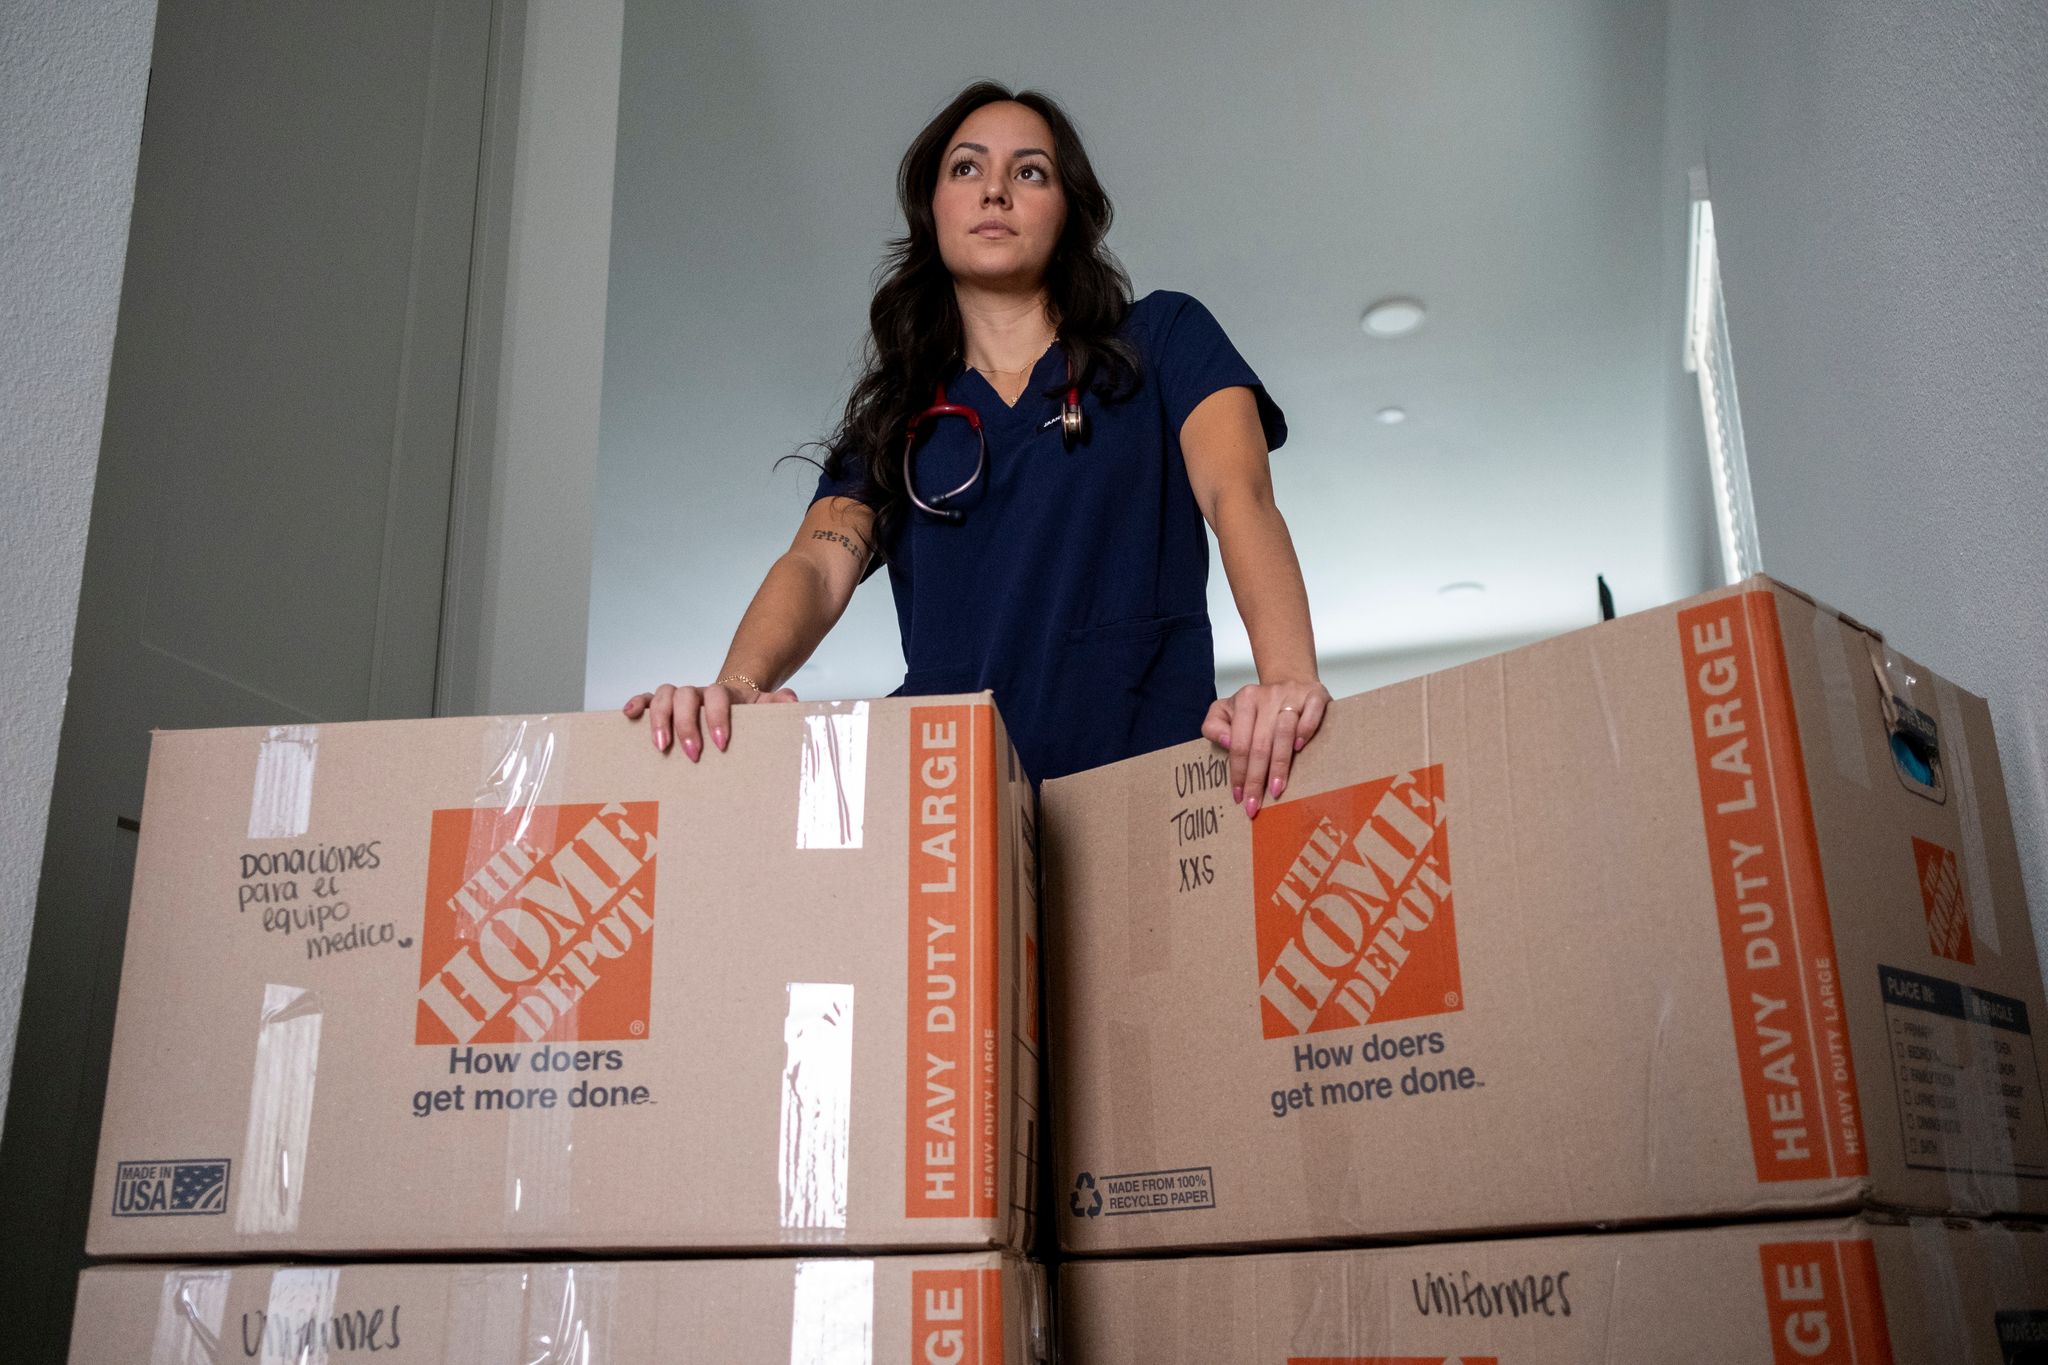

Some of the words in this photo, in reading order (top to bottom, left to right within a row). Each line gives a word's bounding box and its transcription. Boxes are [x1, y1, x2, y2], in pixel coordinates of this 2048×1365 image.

[1692, 616, 1757, 815] LARGE
[921, 721, 957, 892] LARGE
[1170, 805, 1224, 846] Talla:
[240, 841, 381, 879] Donaciones
[447, 840, 545, 923] THE
[1272, 816, 1348, 914] THE
[239, 881, 298, 912] para
[263, 902, 350, 935] equipo
[417, 803, 657, 1044] HOME
[1259, 772, 1446, 1034] HOME
[1729, 839, 1781, 970] DUTY
[507, 887, 654, 1042] DEPOT
[1335, 855, 1452, 1025] DEPOT
[927, 916, 956, 1032] DUTY
[1817, 957, 1839, 1021] LARGE
[450, 1047, 521, 1074] How
[530, 1045, 623, 1072] doers
[1294, 1044, 1353, 1072] How
[1362, 1032, 1445, 1062] doers
[1752, 993, 1811, 1161] HEAVY
[1827, 1029, 1848, 1081] DUTY
[413, 1085, 464, 1117] get
[475, 1088, 557, 1109] more
[984, 1091, 995, 1136] DUTY
[1271, 1082, 1314, 1118] get
[1322, 1077, 1392, 1105] more
[1838, 1089, 1857, 1155] HEAVY
[925, 1052, 956, 1200] HEAVY
[120, 1180, 166, 1211] USA
[122, 1167, 157, 1179] MADE
[159, 1166, 172, 1178] IN
[984, 1143, 995, 1198] HEAVY
[1108, 1180, 1140, 1194] MADE
[1142, 1177, 1175, 1191] FROM
[1177, 1174, 1206, 1189] 100%
[1110, 1193, 1168, 1209] RECYCLED
[1171, 1190, 1208, 1205] PAPER
